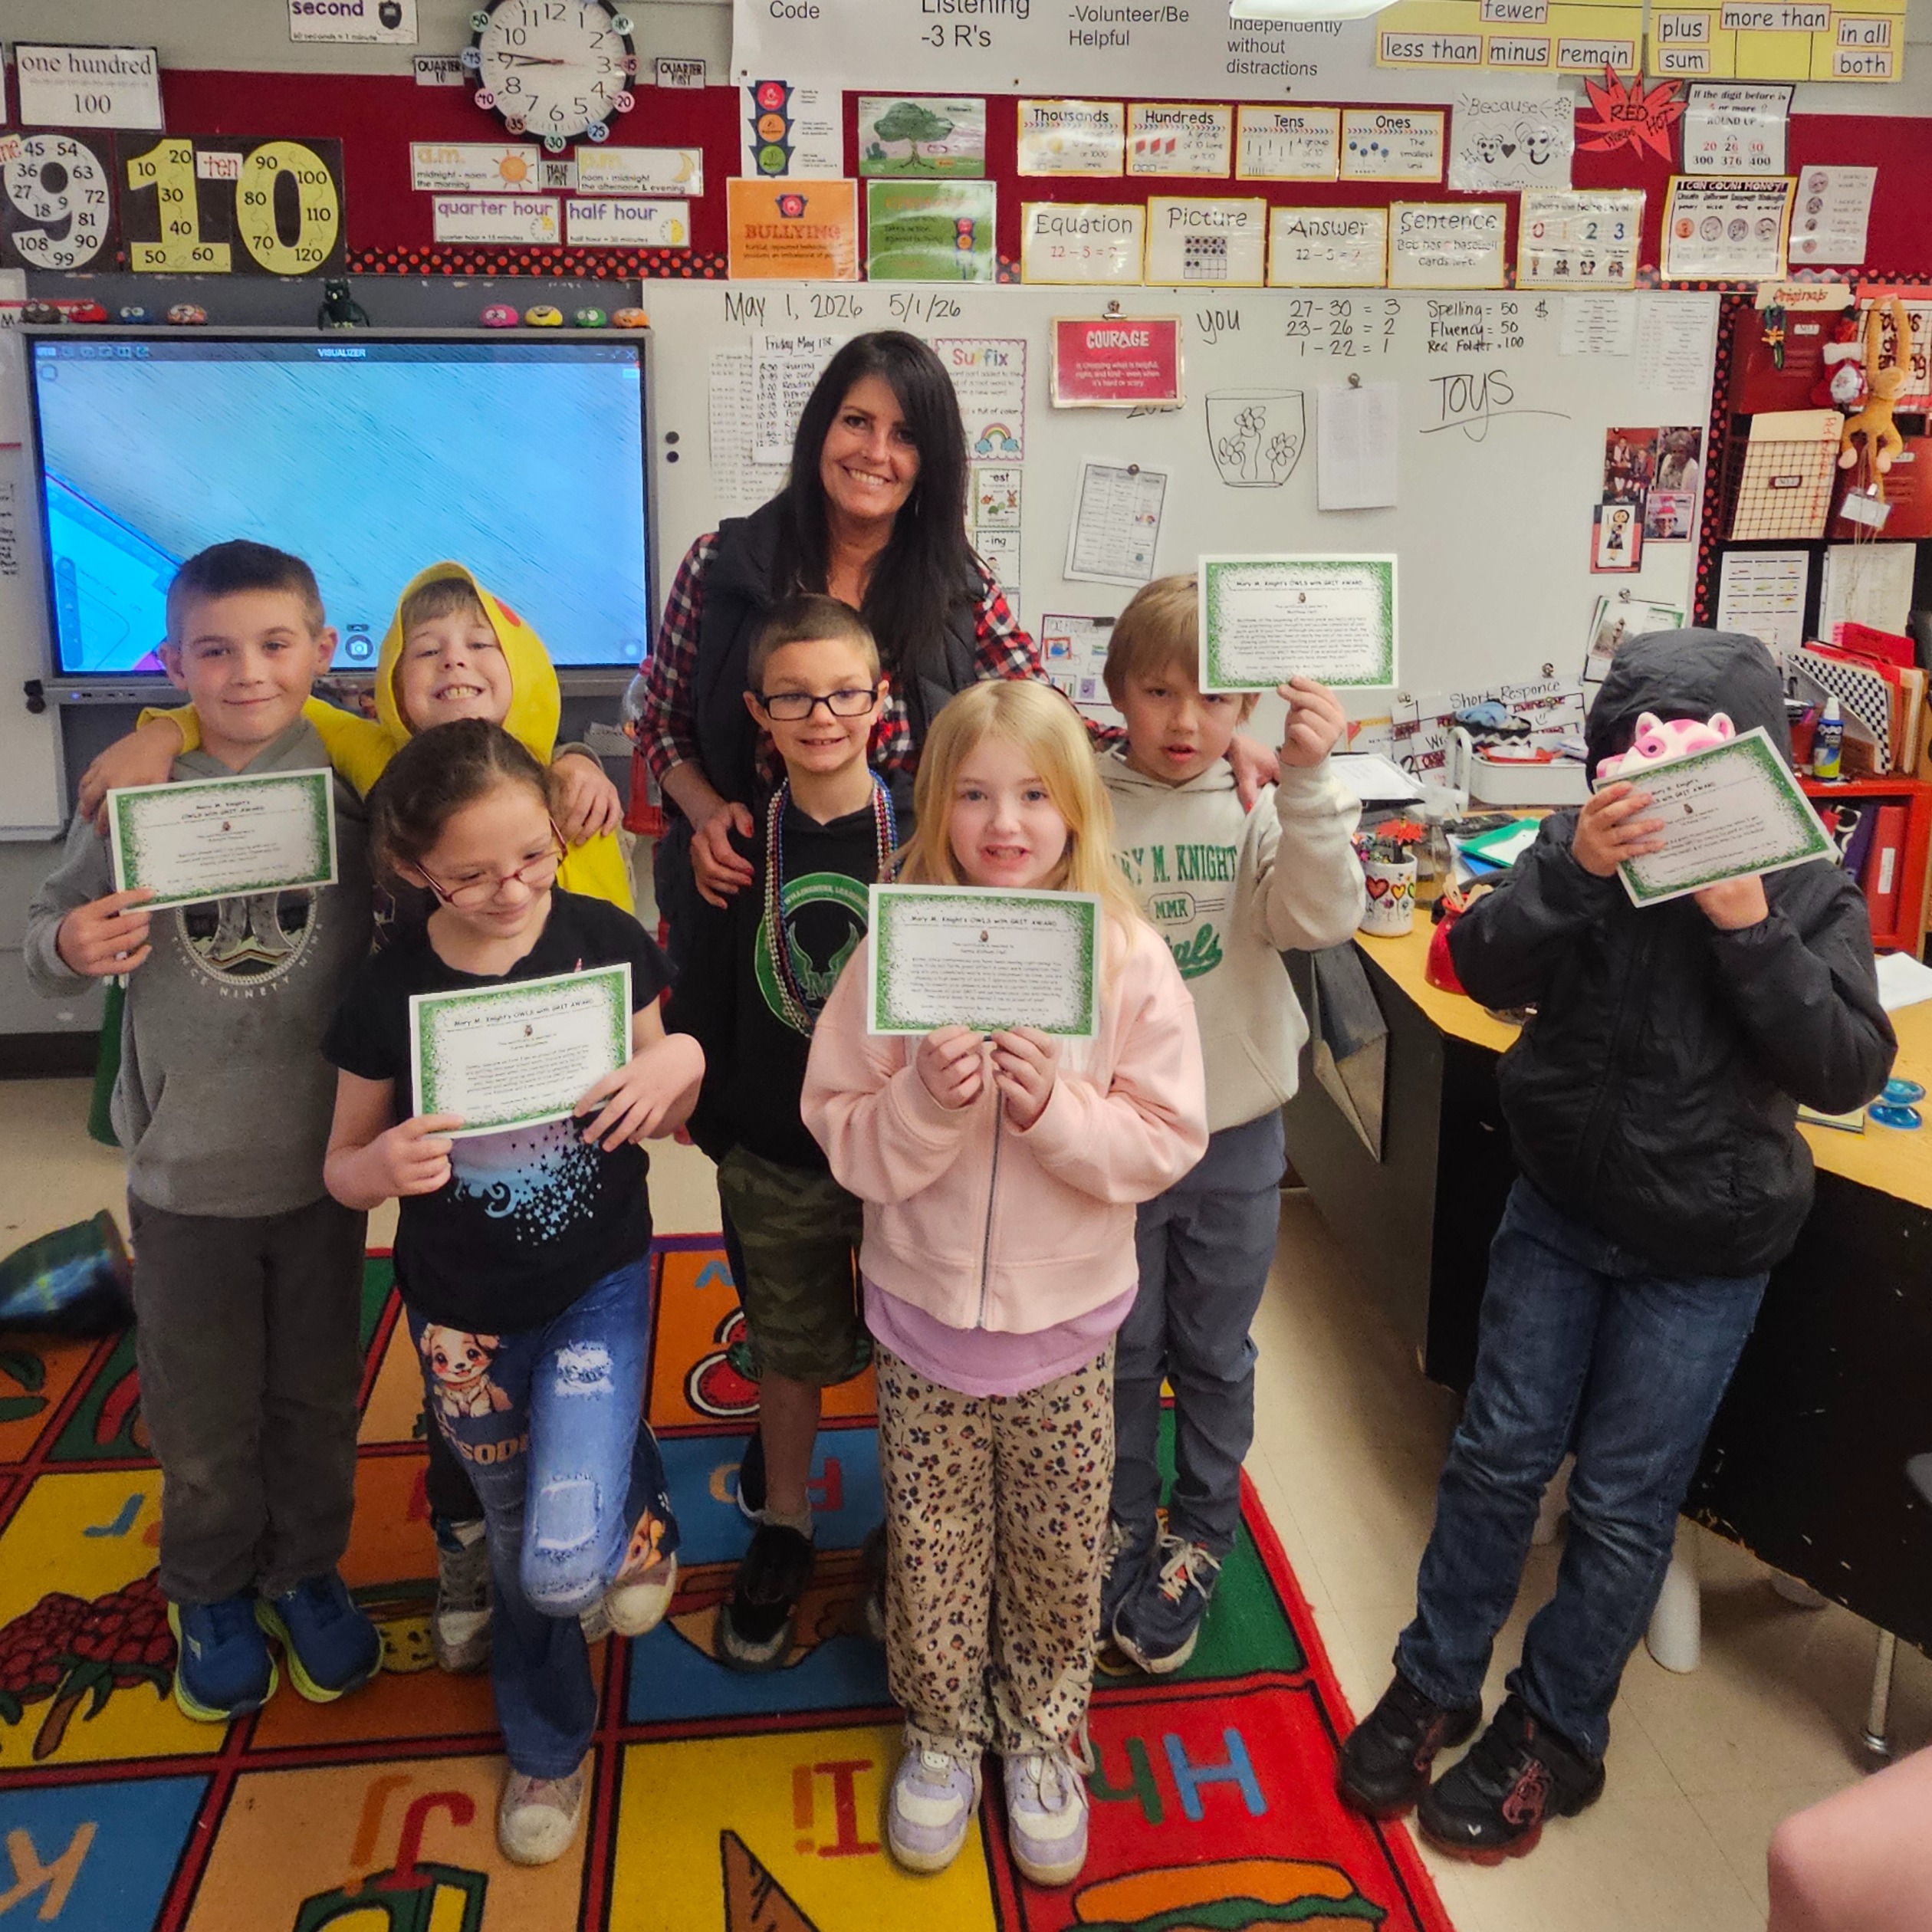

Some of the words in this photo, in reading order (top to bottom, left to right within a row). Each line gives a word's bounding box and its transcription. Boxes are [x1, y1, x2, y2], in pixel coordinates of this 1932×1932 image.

[292, 0, 364, 16] second
[545, 4, 567, 21] 12
[769, 2, 820, 19] Code
[922, 0, 1030, 19] Listening
[1069, 6, 1189, 23] -Volunteer/Be
[1484, 0, 1546, 20] fewer
[523, 9, 538, 26] 11
[579, 12, 584, 29] 1
[1725, 13, 1773, 27] more
[1782, 8, 1825, 28] than
[506, 28, 526, 45] 10
[922, 25, 945, 48] -3
[955, 24, 992, 48] R's
[1663, 17, 1703, 39] plus
[1841, 25, 1857, 43] in
[1864, 24, 1887, 44] all
[590, 31, 604, 49] 2
[1069, 30, 1131, 48] Helpful
[1227, 39, 1286, 54] without
[1386, 36, 1424, 58] less
[1432, 39, 1477, 61] than
[1490, 42, 1546, 62] minus
[1561, 42, 1628, 64] remain
[21, 56, 61, 72] one
[68, 53, 152, 75] hundred
[498, 52, 514, 70] 9
[596, 56, 611, 74] 3
[1227, 60, 1318, 76] distractions
[1664, 53, 1704, 68] sum
[1840, 56, 1885, 74] both
[505, 77, 521, 94] 8
[590, 81, 606, 99] 4
[75, 93, 112, 114] 100
[525, 94, 538, 111] 7
[574, 97, 588, 114] 5
[550, 104, 564, 121] 6
[1033, 108, 1109, 123] Thousands
[1145, 110, 1214, 124] Hundreds
[1273, 114, 1305, 128] Tens
[1611, 104, 1648, 122] RED
[1375, 115, 1411, 129] Ones
[25, 142, 45, 156] 45
[58, 142, 77, 156] 54
[1703, 142, 1717, 152] 20
[1724, 143, 1739, 152] 26
[169, 150, 192, 163] 20
[255, 156, 278, 169] 90
[1693, 156, 1714, 165] 300
[1720, 156, 1742, 166] 376
[1750, 156, 1771, 166] 400
[18, 163, 38, 177] 36
[73, 166, 94, 179] 63
[138, 162, 156, 176] 10
[203, 156, 238, 178] ten
[297, 170, 328, 185] 100
[13, 185, 32, 199] 27
[84, 189, 106, 203] 72
[161, 188, 184, 202] 30
[244, 192, 267, 205] 80
[34, 203, 51, 217] 18
[58, 196, 68, 209] 9
[438, 199, 507, 218] quarter
[513, 200, 553, 215] hour
[569, 202, 607, 220] half
[614, 203, 658, 220] hour
[78, 212, 96, 226] 81
[307, 208, 331, 222] 110
[1167, 207, 1248, 228] Picture
[1401, 211, 1498, 235] Sentence
[169, 221, 192, 235] 40
[744, 224, 841, 240] BULLYING
[1035, 214, 1133, 236] Equation
[1287, 217, 1371, 238] Answer
[1585, 222, 1598, 239] 2
[1613, 222, 1625, 240] 3
[19, 236, 49, 251] 108
[74, 234, 97, 248] 90
[253, 235, 274, 250] 70
[53, 251, 74, 266] 99
[145, 250, 167, 264] 50
[192, 248, 214, 261] 60
[295, 248, 323, 261] 120
[724, 291, 766, 327] May
[786, 294, 800, 320] 1,
[810, 294, 863, 317] 2026
[889, 293, 961, 323] 5/1/26
[1329, 299, 1352, 317] 30
[1384, 299, 1401, 315] 3
[1427, 300, 1483, 324] Spelling
[1500, 302, 1519, 315] 50
[1196, 309, 1240, 345] you
[1329, 319, 1353, 336] 26
[1383, 317, 1395, 335] 2
[1431, 320, 1484, 342] Fluency
[1500, 320, 1519, 334] 50
[797, 336, 815, 353] May
[1086, 330, 1150, 349] COURAGE
[1329, 340, 1356, 356] 22
[1505, 336, 1524, 348] 100
[317, 348, 366, 358] VISUALIZER
[1450, 692, 1497, 710] Short
[1153, 845, 1171, 883] M.
[1177, 844, 1238, 882] KNIGHT
[1154, 899, 1189, 919] MMK
[219, 975, 290, 998] NINETY
